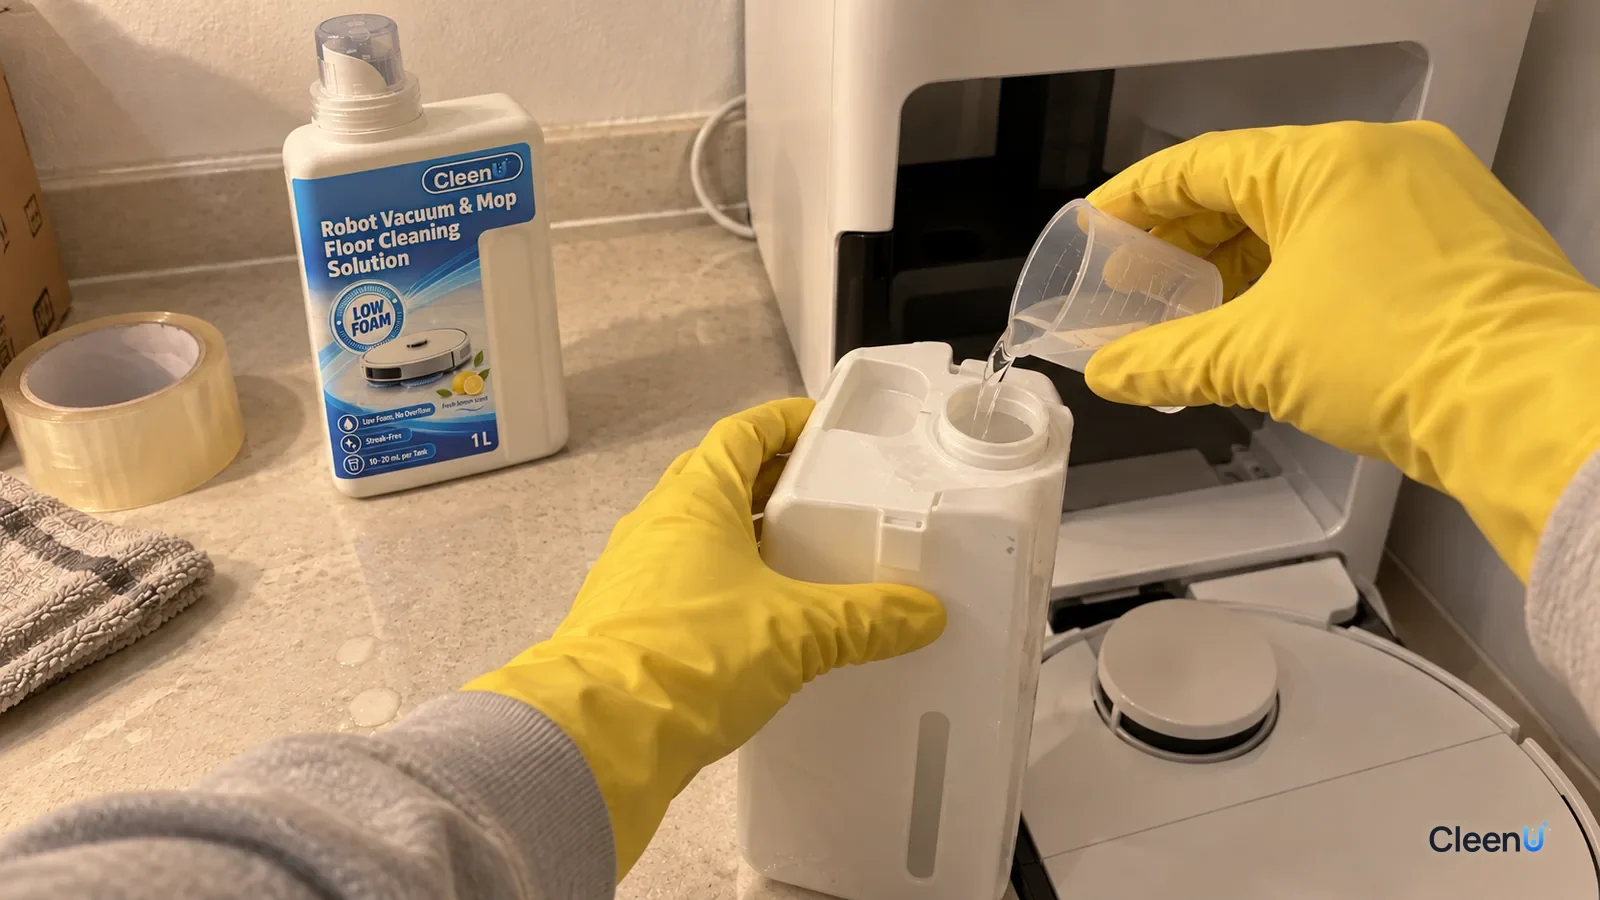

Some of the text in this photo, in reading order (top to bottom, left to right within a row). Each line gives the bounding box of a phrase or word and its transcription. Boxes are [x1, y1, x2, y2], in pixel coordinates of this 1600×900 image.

[434, 160, 507, 189] CleenU
[320, 192, 517, 238] Robot Vacuum & Mop
[324, 222, 461, 258] Floor Cleaning
[327, 252, 410, 278] Solution
[352, 299, 384, 321] LOW
[351, 312, 391, 337] FOAM
[365, 433, 402, 445] Streak-Free
[471, 431, 491, 447] 1 L
[369, 455, 390, 465] 10-20
